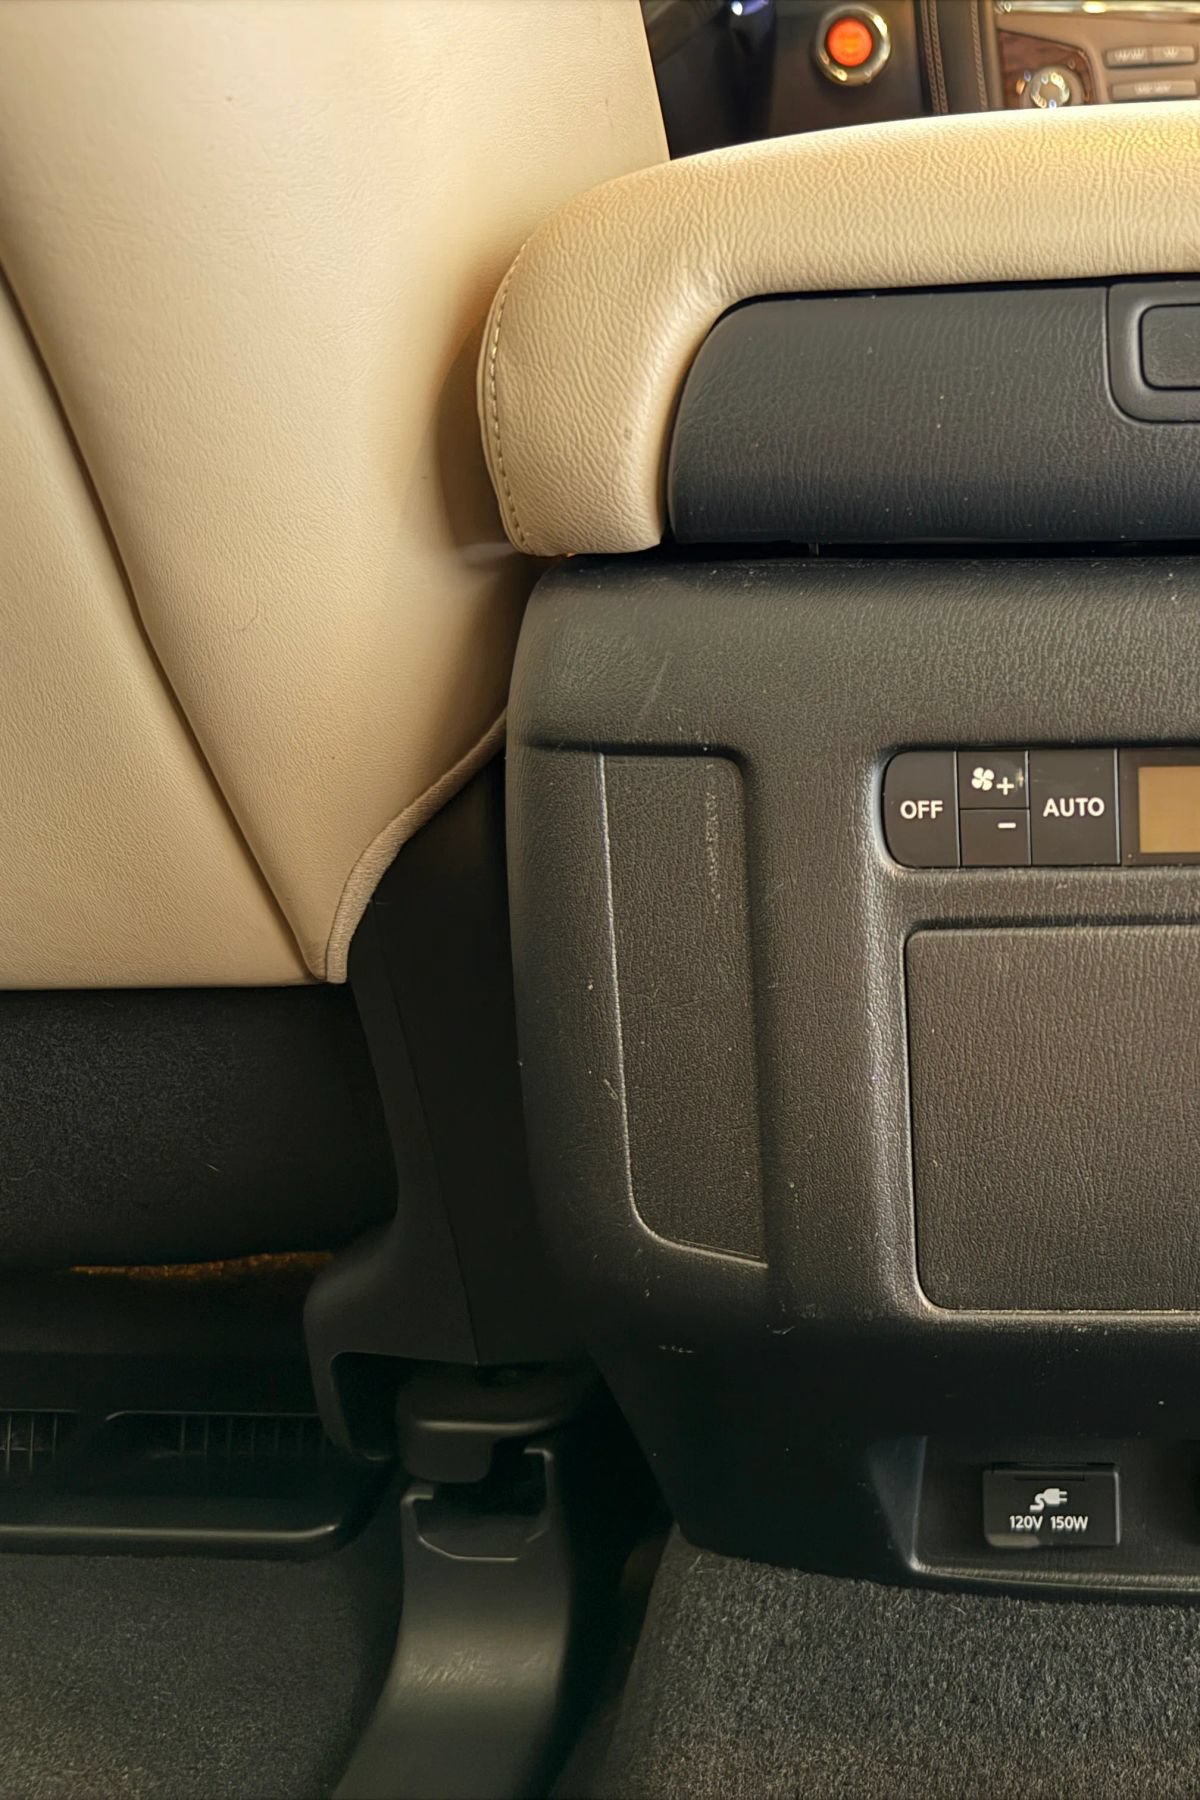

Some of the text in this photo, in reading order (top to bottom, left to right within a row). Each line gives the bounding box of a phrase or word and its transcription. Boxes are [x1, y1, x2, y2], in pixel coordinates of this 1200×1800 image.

[900, 800, 943, 820] OFF
[1042, 796, 1105, 817] AUTO
[1009, 1515, 1089, 1531] 120V 150W
